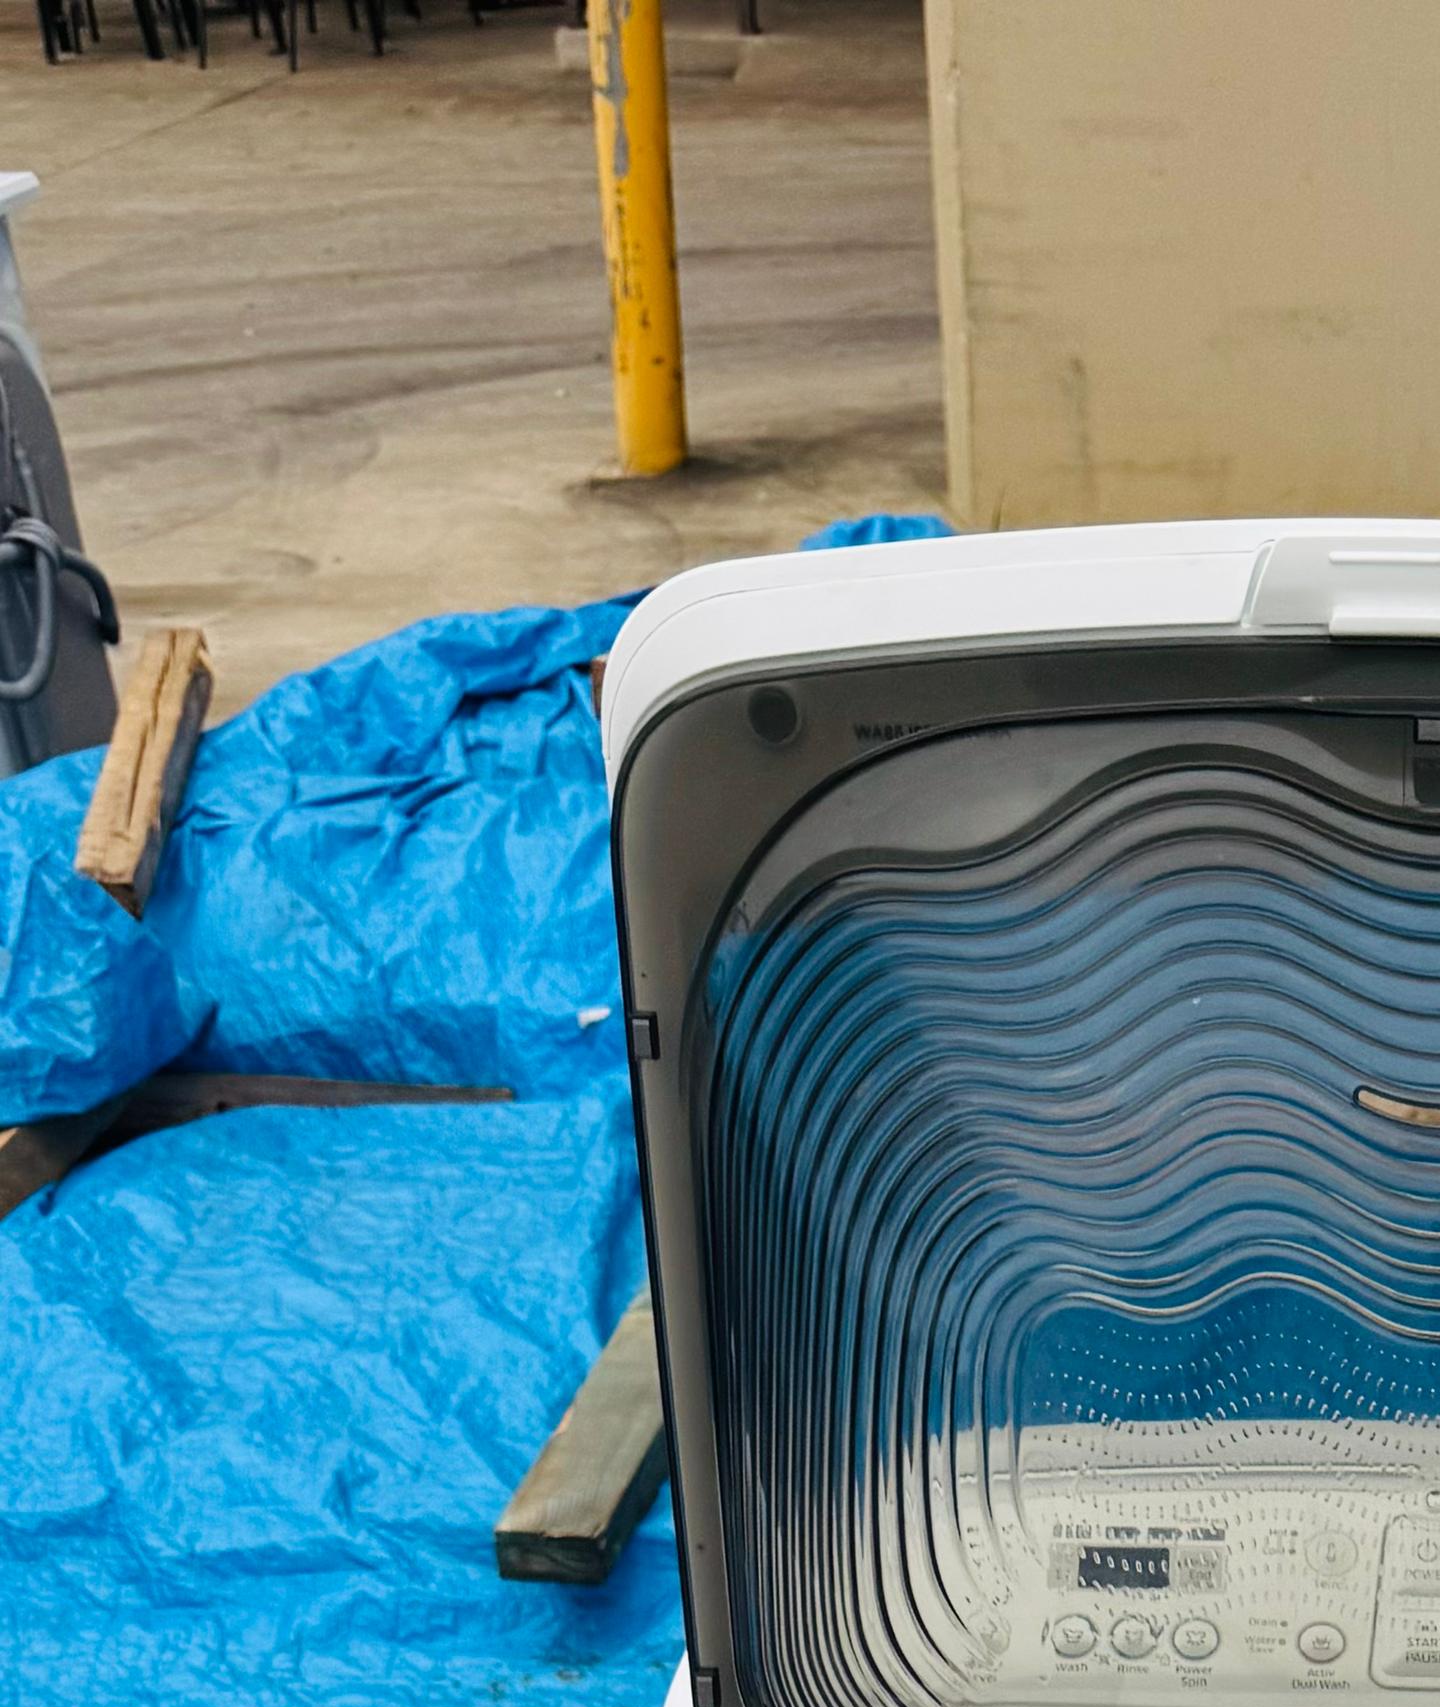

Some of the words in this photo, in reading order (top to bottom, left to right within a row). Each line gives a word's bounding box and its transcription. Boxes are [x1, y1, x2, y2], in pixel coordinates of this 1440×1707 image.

[1055, 1662, 1089, 1674] Wash
[1116, 1663, 1151, 1675] Rinse
[1175, 1664, 1214, 1675] Power
[1307, 1667, 1336, 1678] Activ
[1180, 1675, 1208, 1689] Spin
